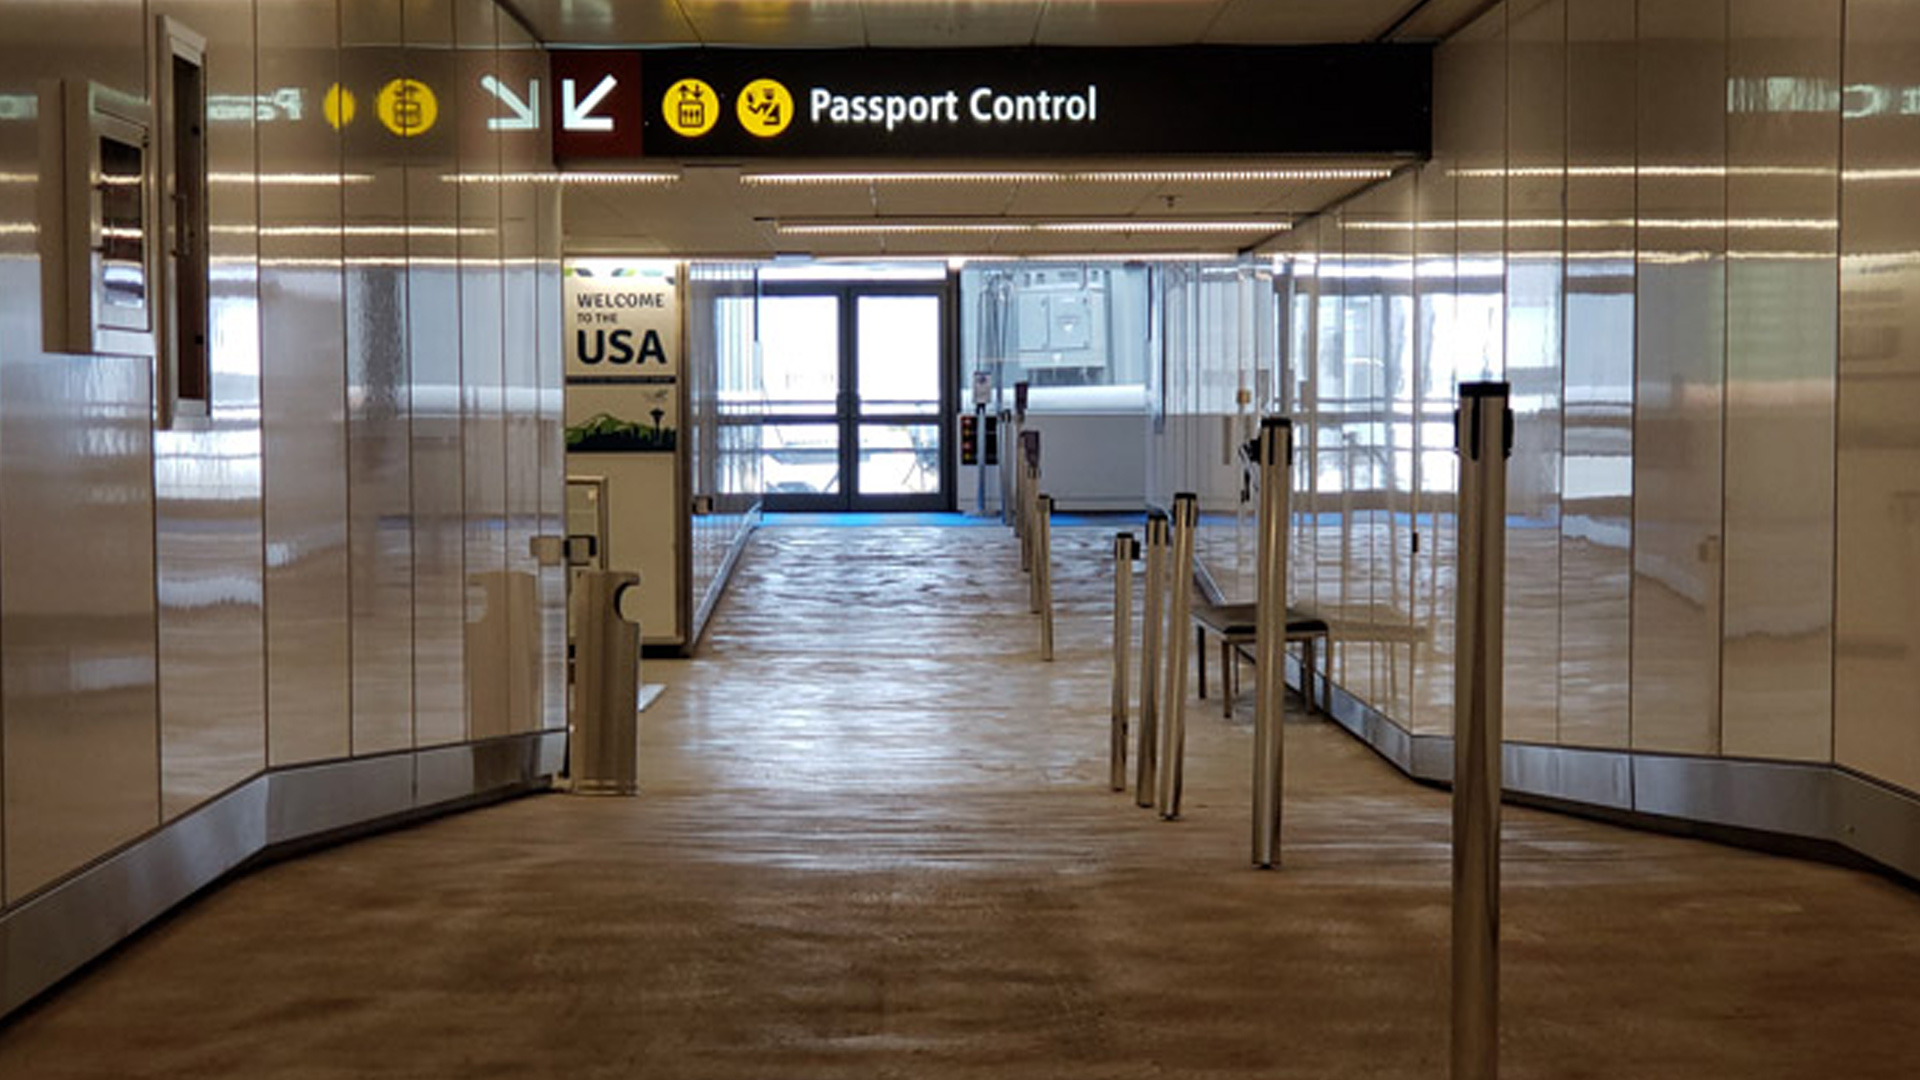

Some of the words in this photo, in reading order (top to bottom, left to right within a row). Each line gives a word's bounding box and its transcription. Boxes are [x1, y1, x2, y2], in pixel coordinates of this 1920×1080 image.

[810, 87, 959, 131] Passport
[969, 85, 1097, 122] Control
[577, 293, 665, 308] WELCOME
[577, 313, 592, 324] TO
[596, 313, 618, 324] THE
[577, 329, 668, 366] USA
